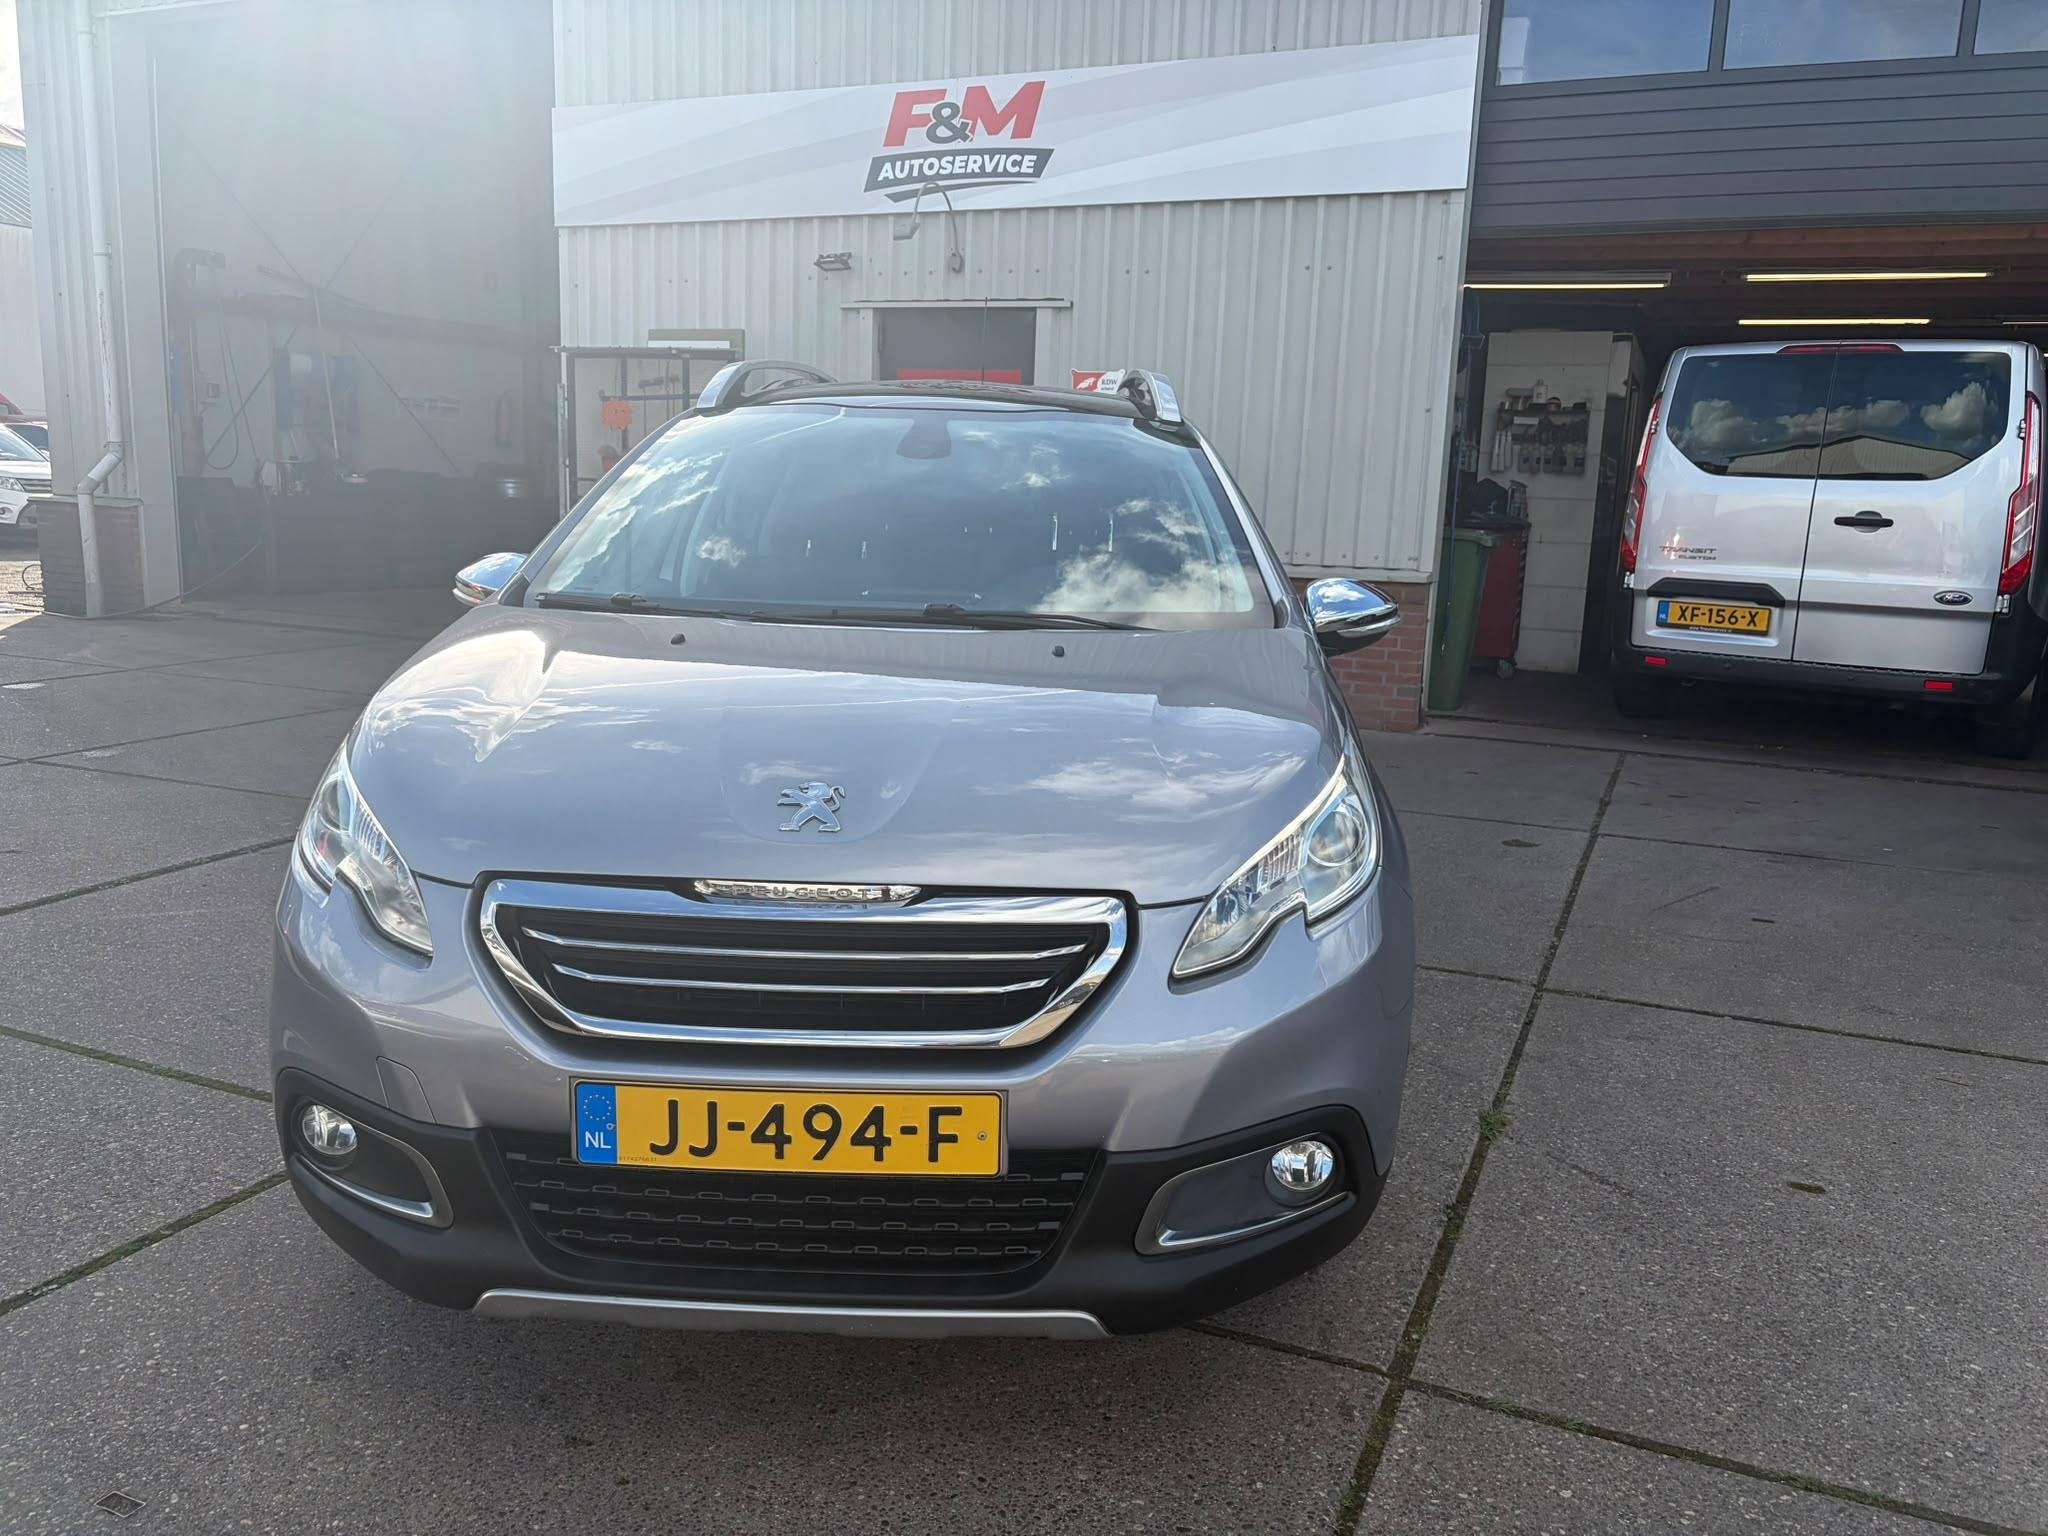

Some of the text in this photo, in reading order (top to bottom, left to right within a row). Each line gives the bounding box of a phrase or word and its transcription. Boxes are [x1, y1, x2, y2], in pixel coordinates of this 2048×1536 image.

[883, 81, 1045, 147] F&M
[877, 154, 1037, 181] AUTOSERVICE
[1677, 605, 1760, 628] XF-156-X
[731, 883, 872, 900] PEUGEOT
[585, 1098, 964, 1162] NL JJ-494-F
